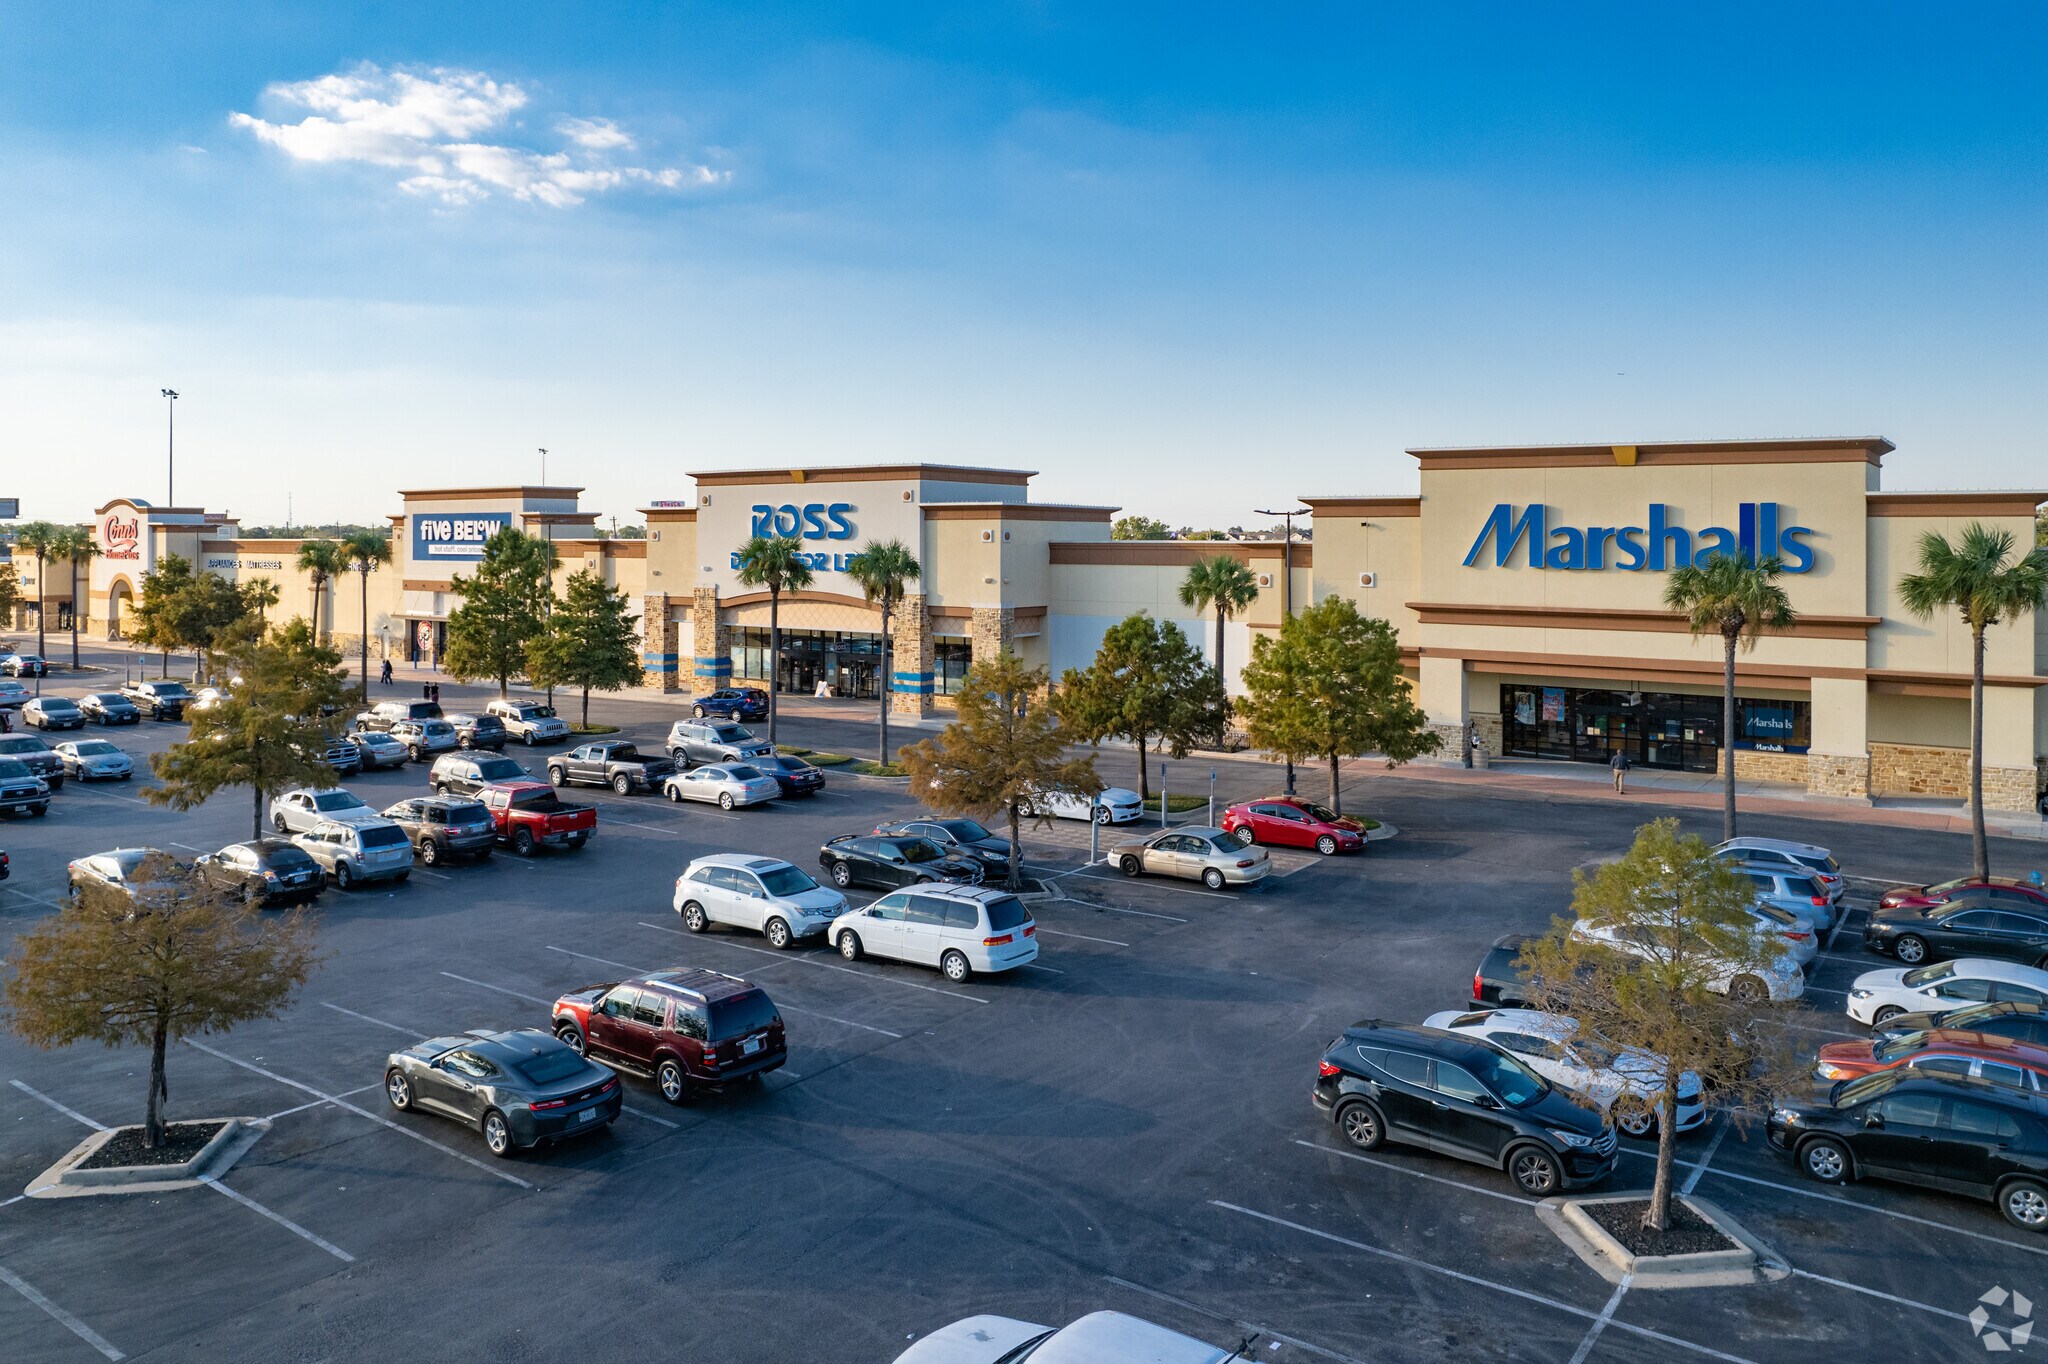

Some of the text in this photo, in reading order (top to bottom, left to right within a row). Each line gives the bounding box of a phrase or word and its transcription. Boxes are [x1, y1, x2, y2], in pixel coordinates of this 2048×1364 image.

[104, 515, 138, 549] Conn's
[420, 519, 452, 541] five
[752, 503, 853, 540] ROSS
[1462, 502, 1815, 574] Marshalls
[1747, 717, 1793, 729] Marshals
[1754, 743, 1784, 752] Marshalls
